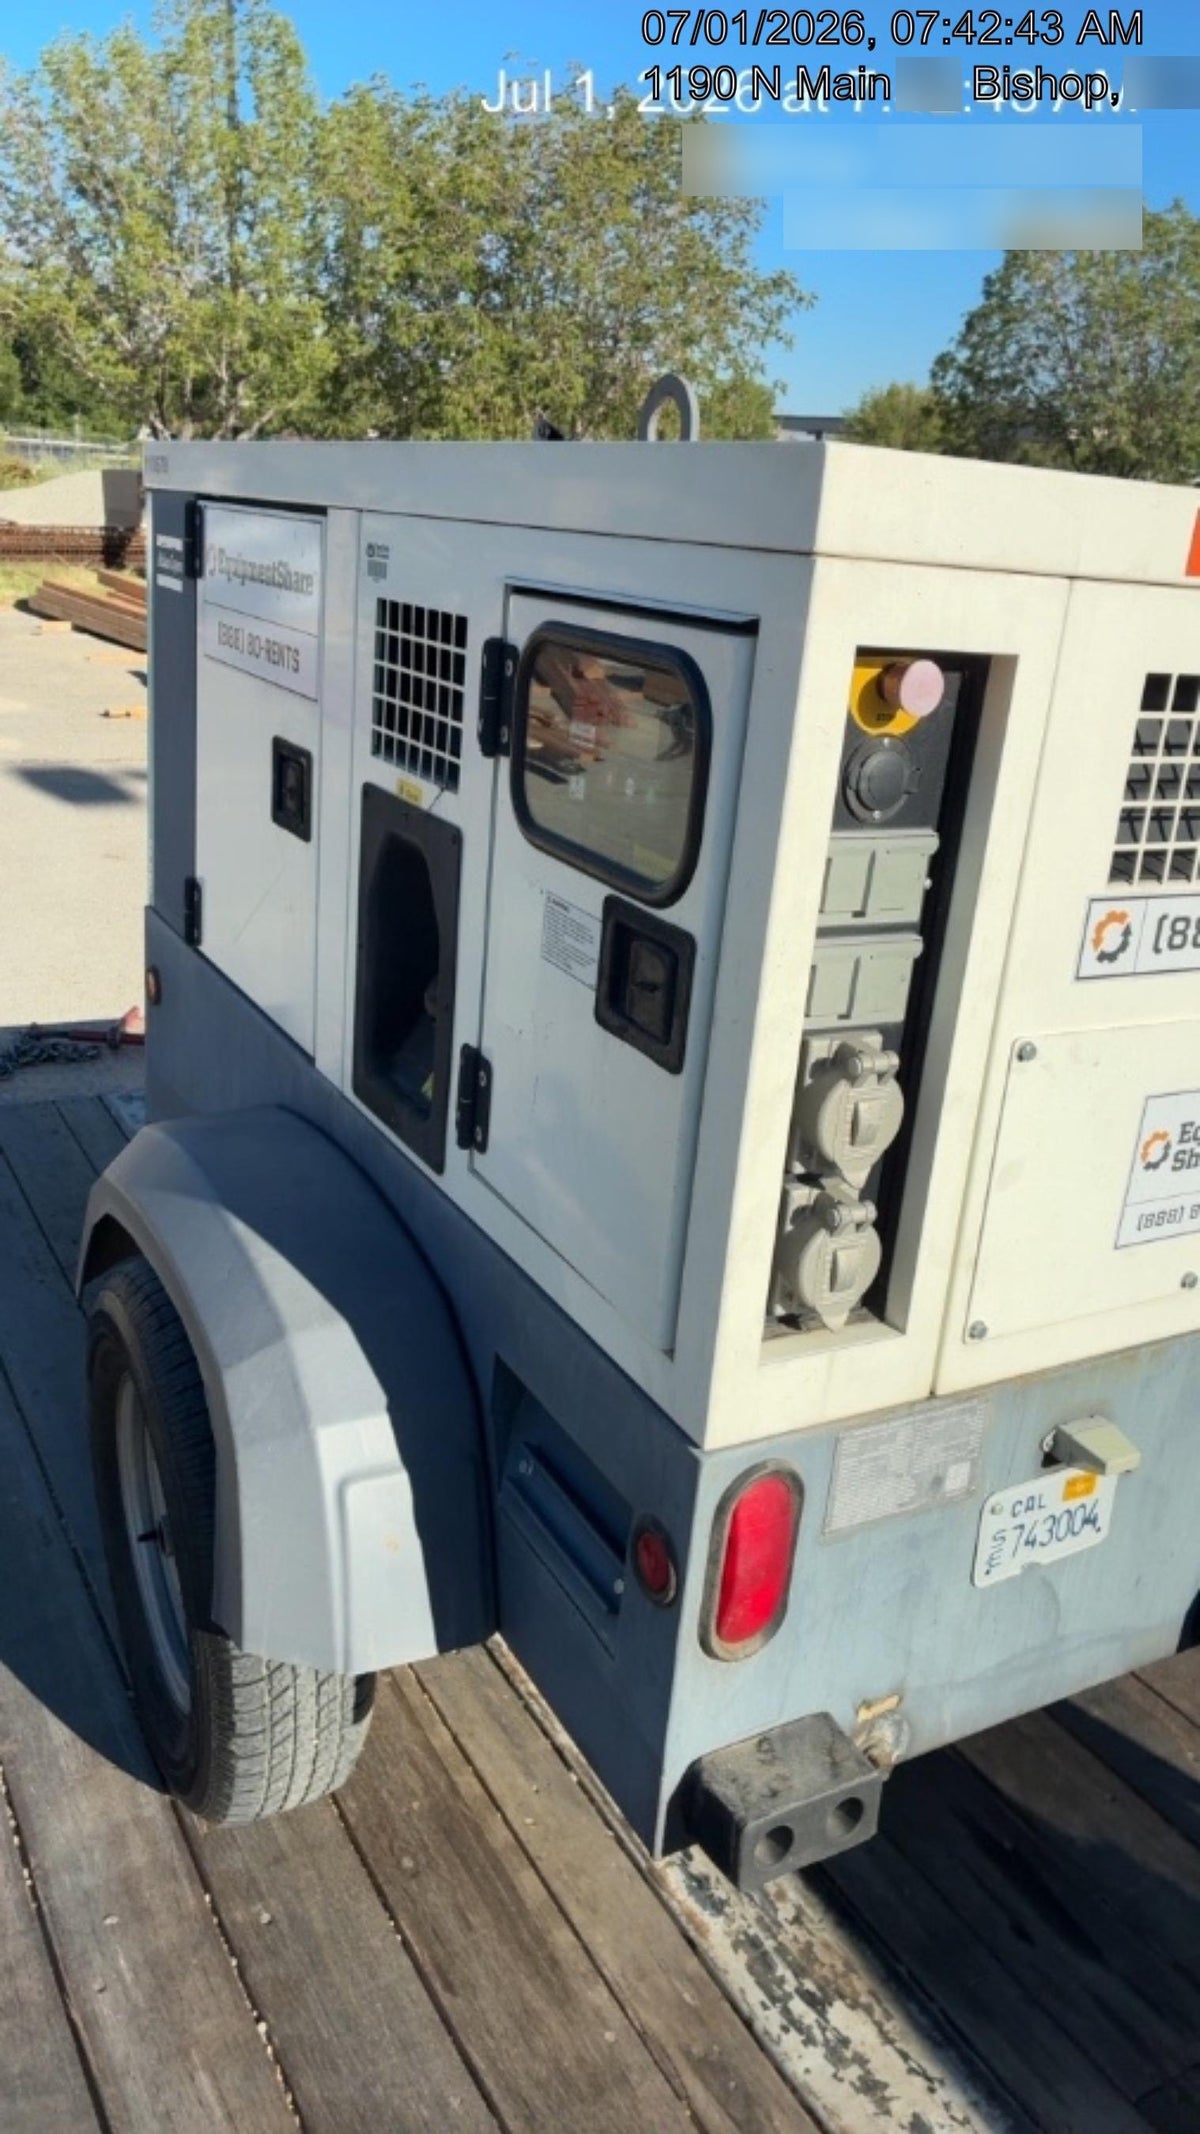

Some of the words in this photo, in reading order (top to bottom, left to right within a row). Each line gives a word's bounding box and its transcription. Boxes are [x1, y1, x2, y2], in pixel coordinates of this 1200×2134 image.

[218, 547, 314, 596] EquipmentShare
[247, 632, 300, 674] 80-RENTS
[1137, 1205, 1185, 1231] (888)
[1011, 1493, 1046, 1518] CAL
[1012, 1498, 1099, 1558] 743004
